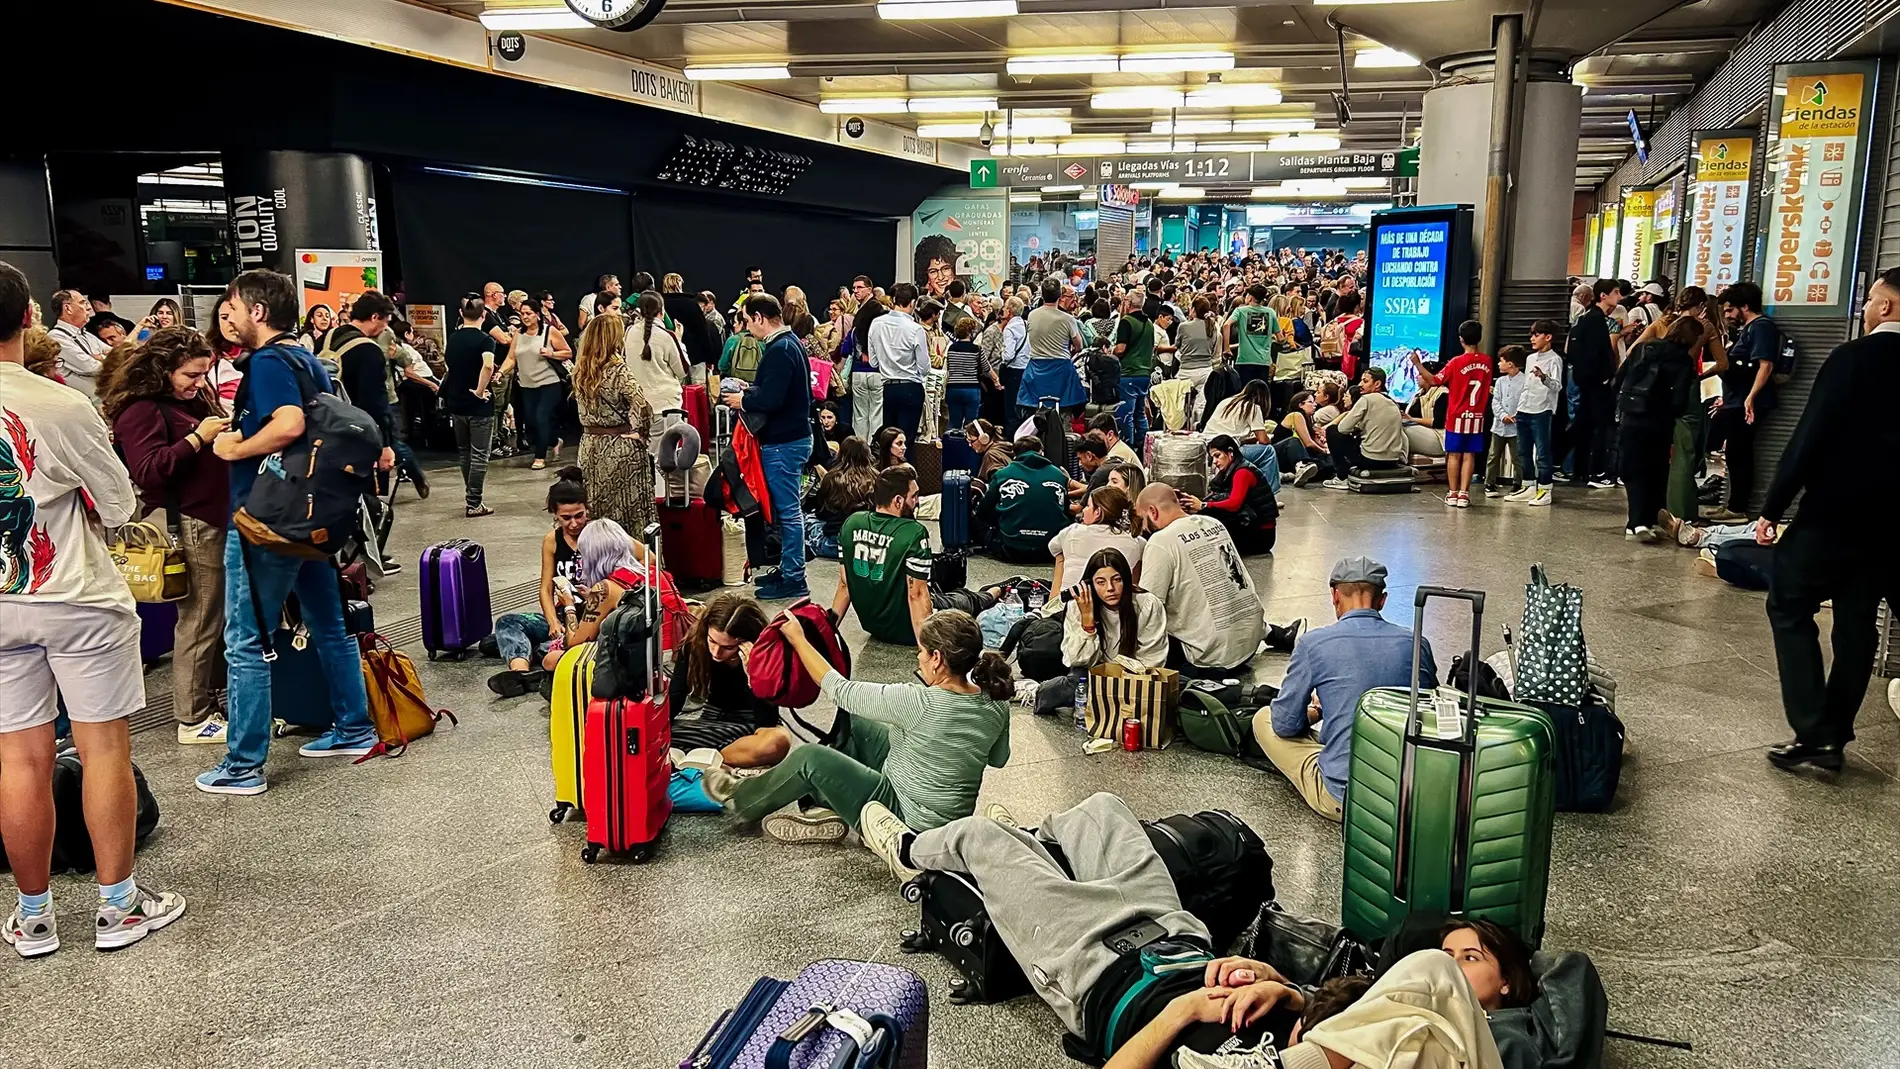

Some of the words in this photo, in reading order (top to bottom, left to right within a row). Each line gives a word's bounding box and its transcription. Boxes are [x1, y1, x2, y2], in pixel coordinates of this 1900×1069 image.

[602, 0, 612, 12] 6
[501, 37, 520, 49] DOTS
[631, 69, 657, 96] DOTS
[659, 76, 695, 105] BAKERY
[848, 122, 861, 131] DOTS
[1798, 122, 1810, 130] de
[1811, 121, 1819, 129] la
[1820, 120, 1856, 129] estación
[903, 135, 916, 153] DOTS
[917, 138, 934, 158] BAKERY
[1118, 161, 1158, 172] Llegadas
[1160, 160, 1180, 170] Vías
[1185, 159, 1196, 177] 1
[1204, 158, 1230, 177] 12
[1280, 156, 1315, 167] Salidas
[1317, 154, 1350, 165] Planta
[1353, 152, 1376, 165] Baja
[1002, 164, 1029, 175] renfe
[273, 187, 287, 209] COOL
[355, 191, 365, 225] CLASSIC
[257, 195, 278, 251] QUALITY
[1380, 230, 1396, 245] MÁS
[1395, 232, 1405, 244] DE
[1405, 231, 1418, 243] UNA
[1419, 228, 1444, 243] DÉCADA
[1694, 184, 1717, 287] uperskunk
[955, 238, 1004, 275] 29
[1392, 247, 1401, 258] DE
[1402, 246, 1430, 258] TRABAJO
[1382, 261, 1413, 274] LUCHANDO
[1414, 260, 1438, 273] CONTRA
[1382, 276, 1390, 288] LA
[1391, 273, 1436, 288] DESPOBLACIÓN
[1384, 297, 1417, 314] SSPA
[1469, 380, 1481, 406] 7
[1461, 410, 1474, 418] ria
[852, 529, 894, 548] MALFOY
[1177, 530, 1201, 544] Los
[123, 565, 140, 573] THE
[852, 543, 887, 581] 07
[133, 574, 157, 582] BAG
